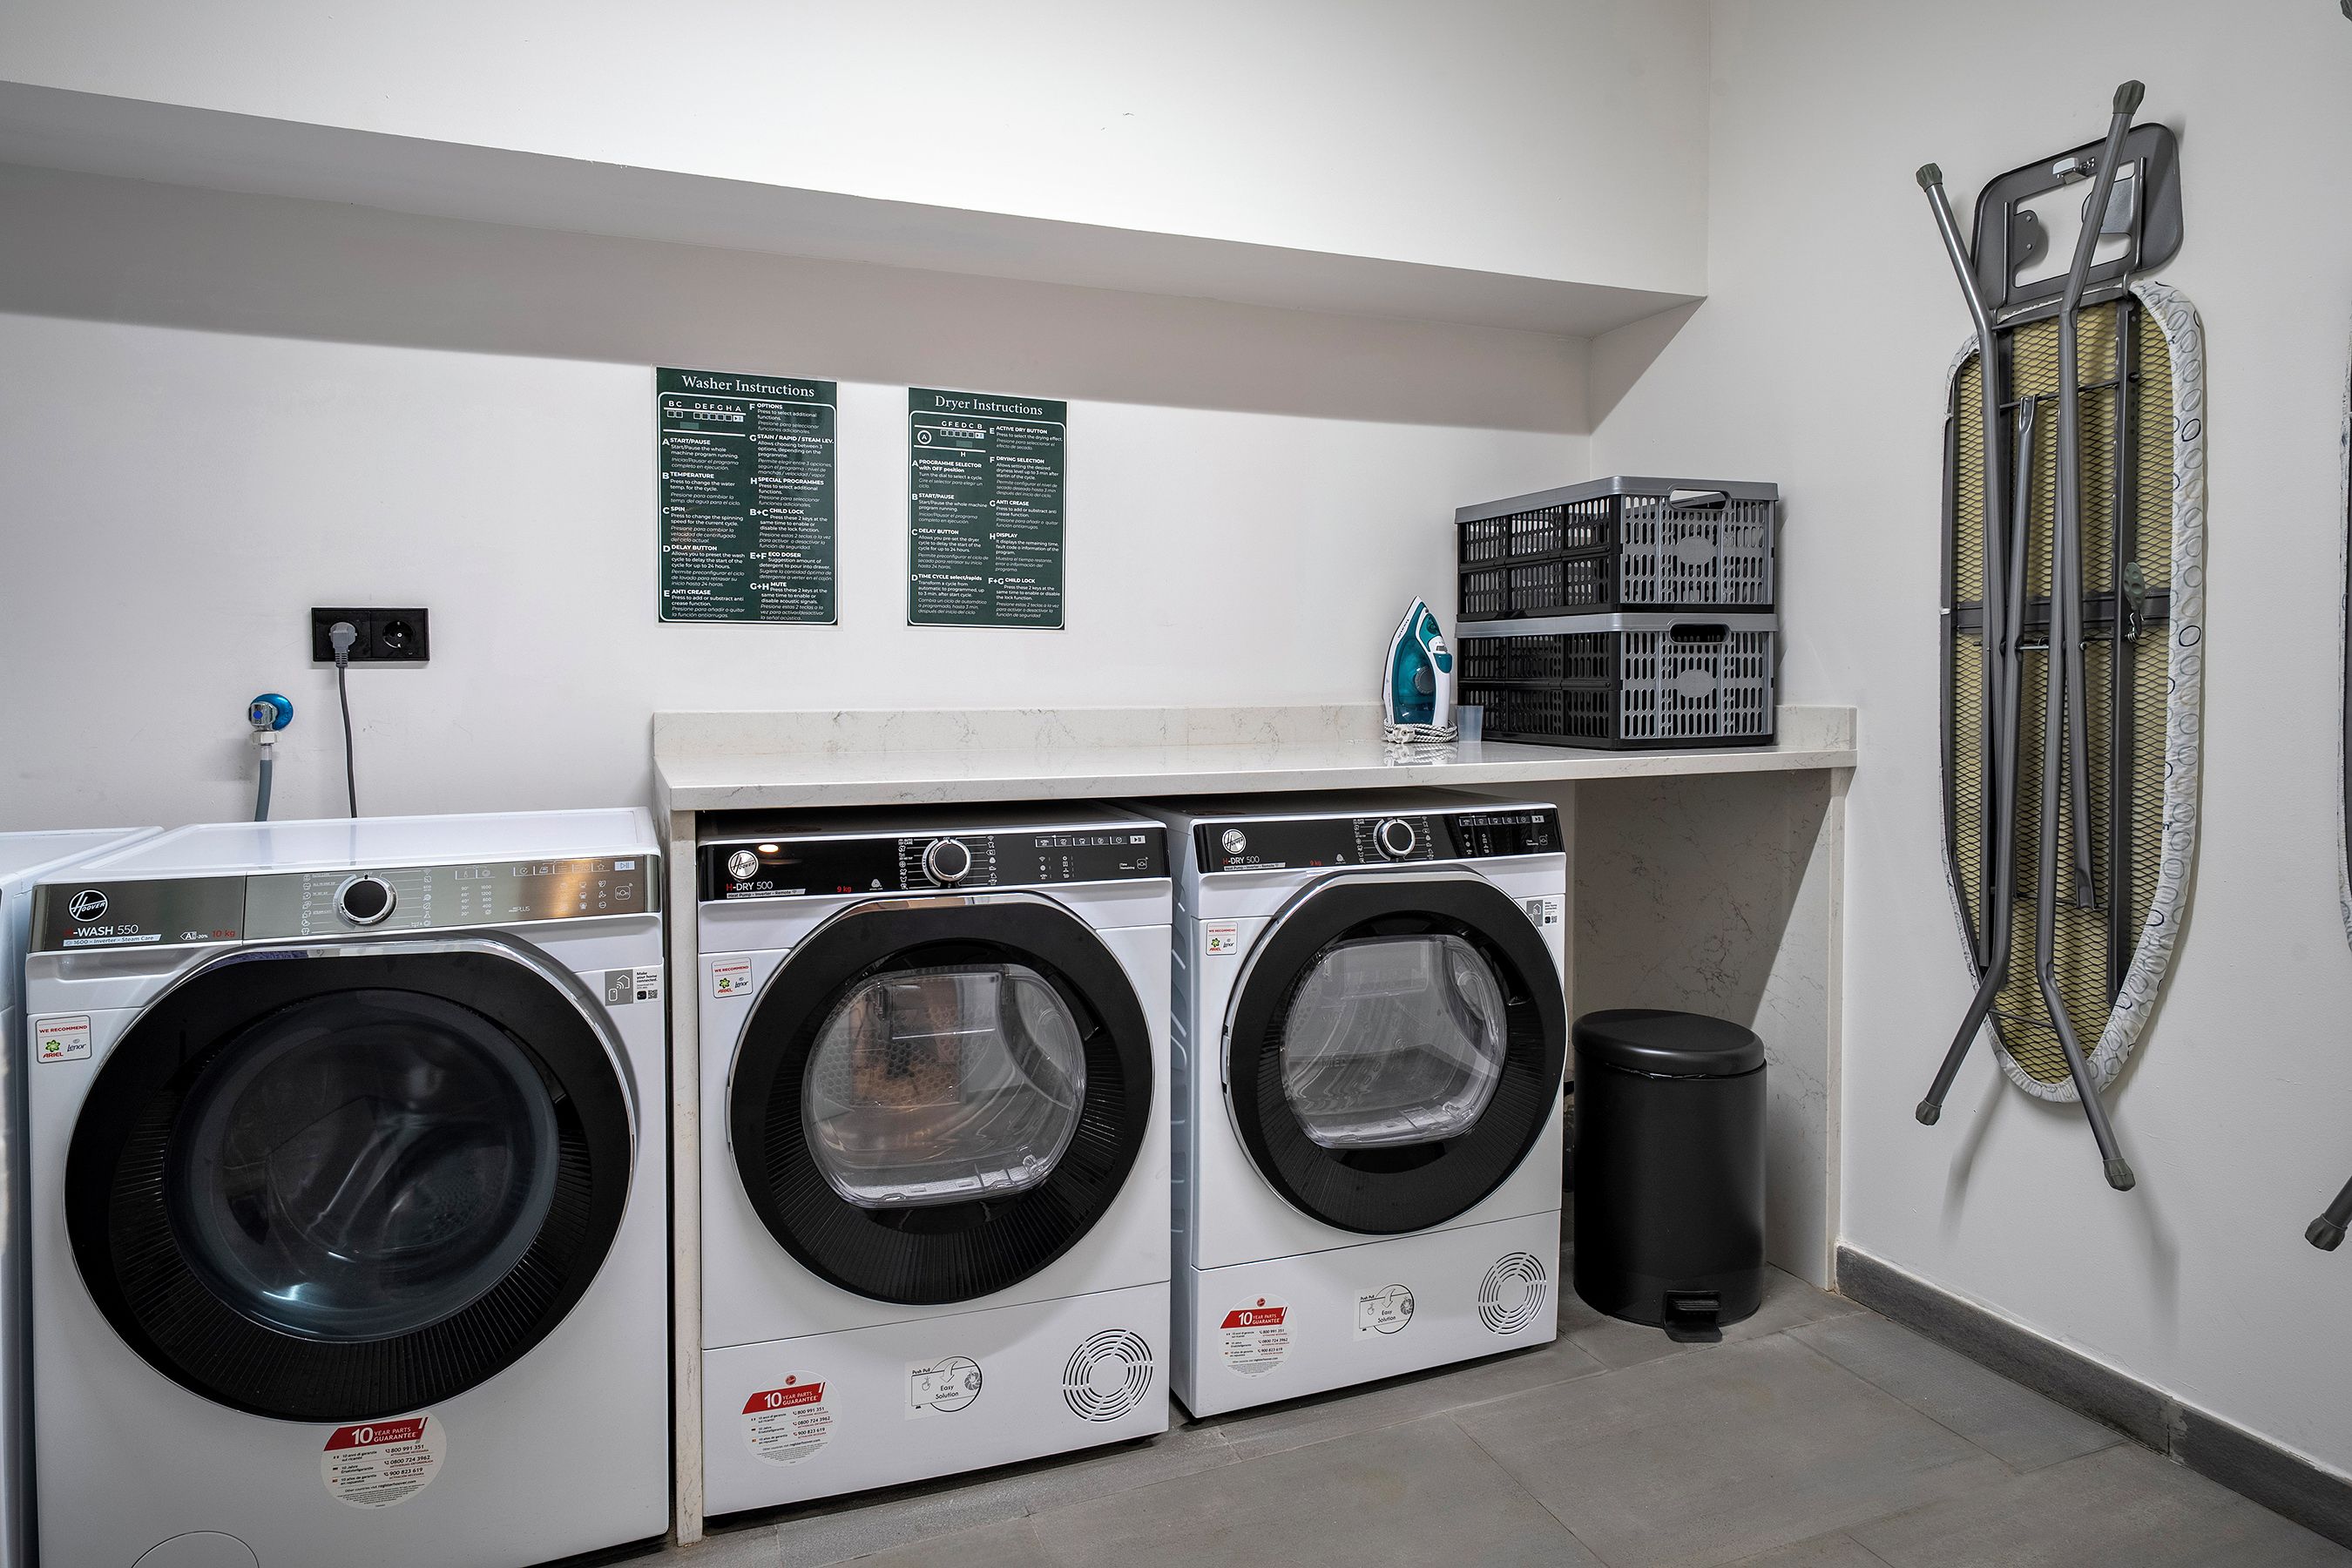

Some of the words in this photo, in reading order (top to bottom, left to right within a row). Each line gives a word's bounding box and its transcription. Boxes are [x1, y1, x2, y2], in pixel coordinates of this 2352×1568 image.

[681, 375, 732, 390] Washer
[735, 379, 814, 397] Instructions
[935, 395, 970, 412] Dryer
[973, 398, 1042, 415] Instructions
[1246, 855, 1260, 864] 500
[727, 882, 754, 892] H-DRY
[756, 881, 773, 890] 500
[118, 924, 139, 935] 550
[225, 929, 236, 938] kg
[67, 1044, 86, 1052] Lenor
[1238, 1312, 1253, 1325] 10
[764, 1392, 782, 1408] 10
[782, 1396, 817, 1406] GUARANTEE
[351, 1427, 374, 1445] 10
[373, 1432, 416, 1443] GUARANTEE
